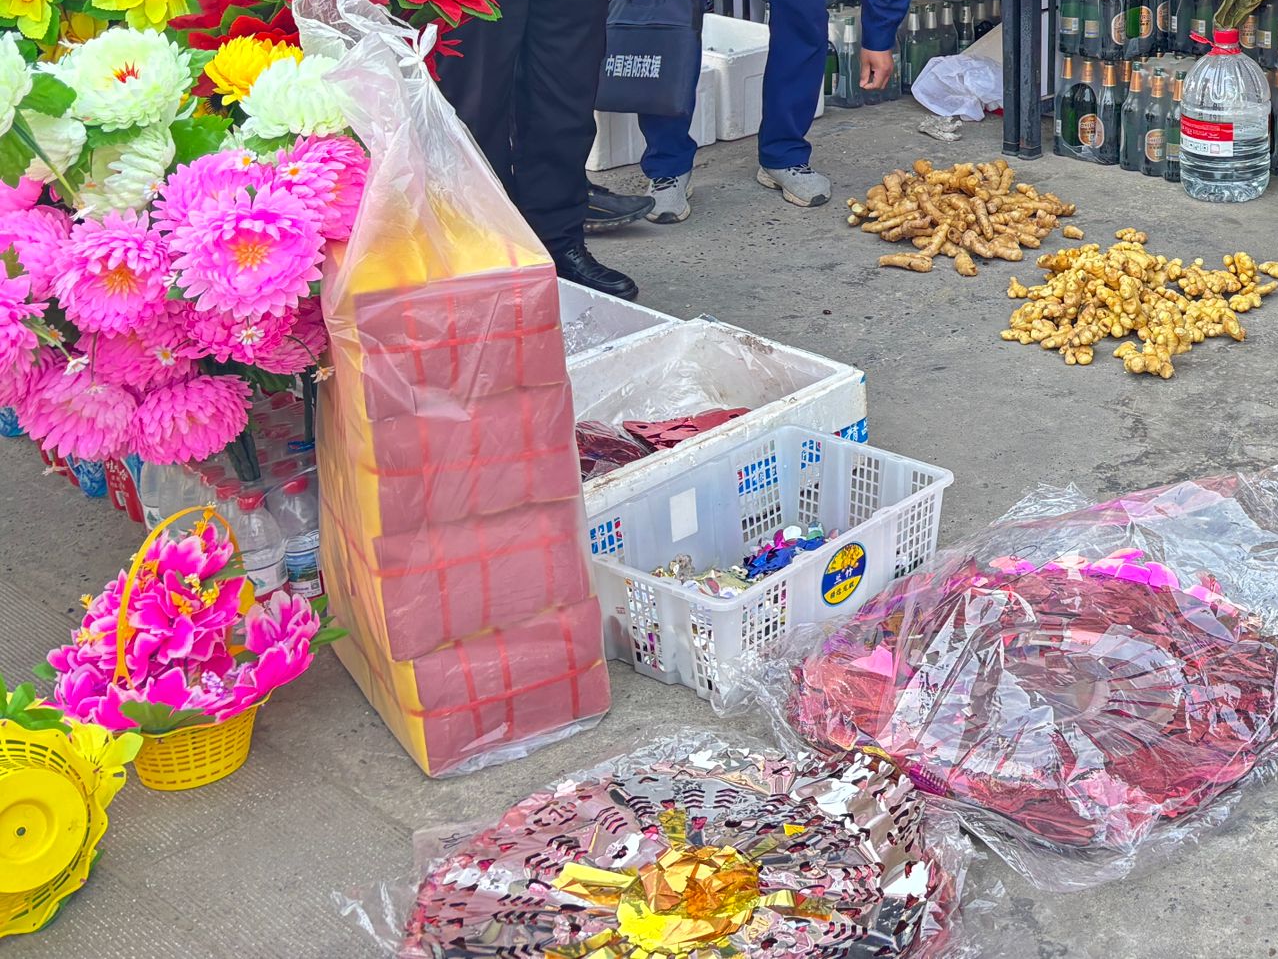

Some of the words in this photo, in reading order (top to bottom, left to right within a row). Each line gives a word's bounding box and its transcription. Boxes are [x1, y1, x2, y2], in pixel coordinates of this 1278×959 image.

[605, 55, 661, 78] 中国消防救援
